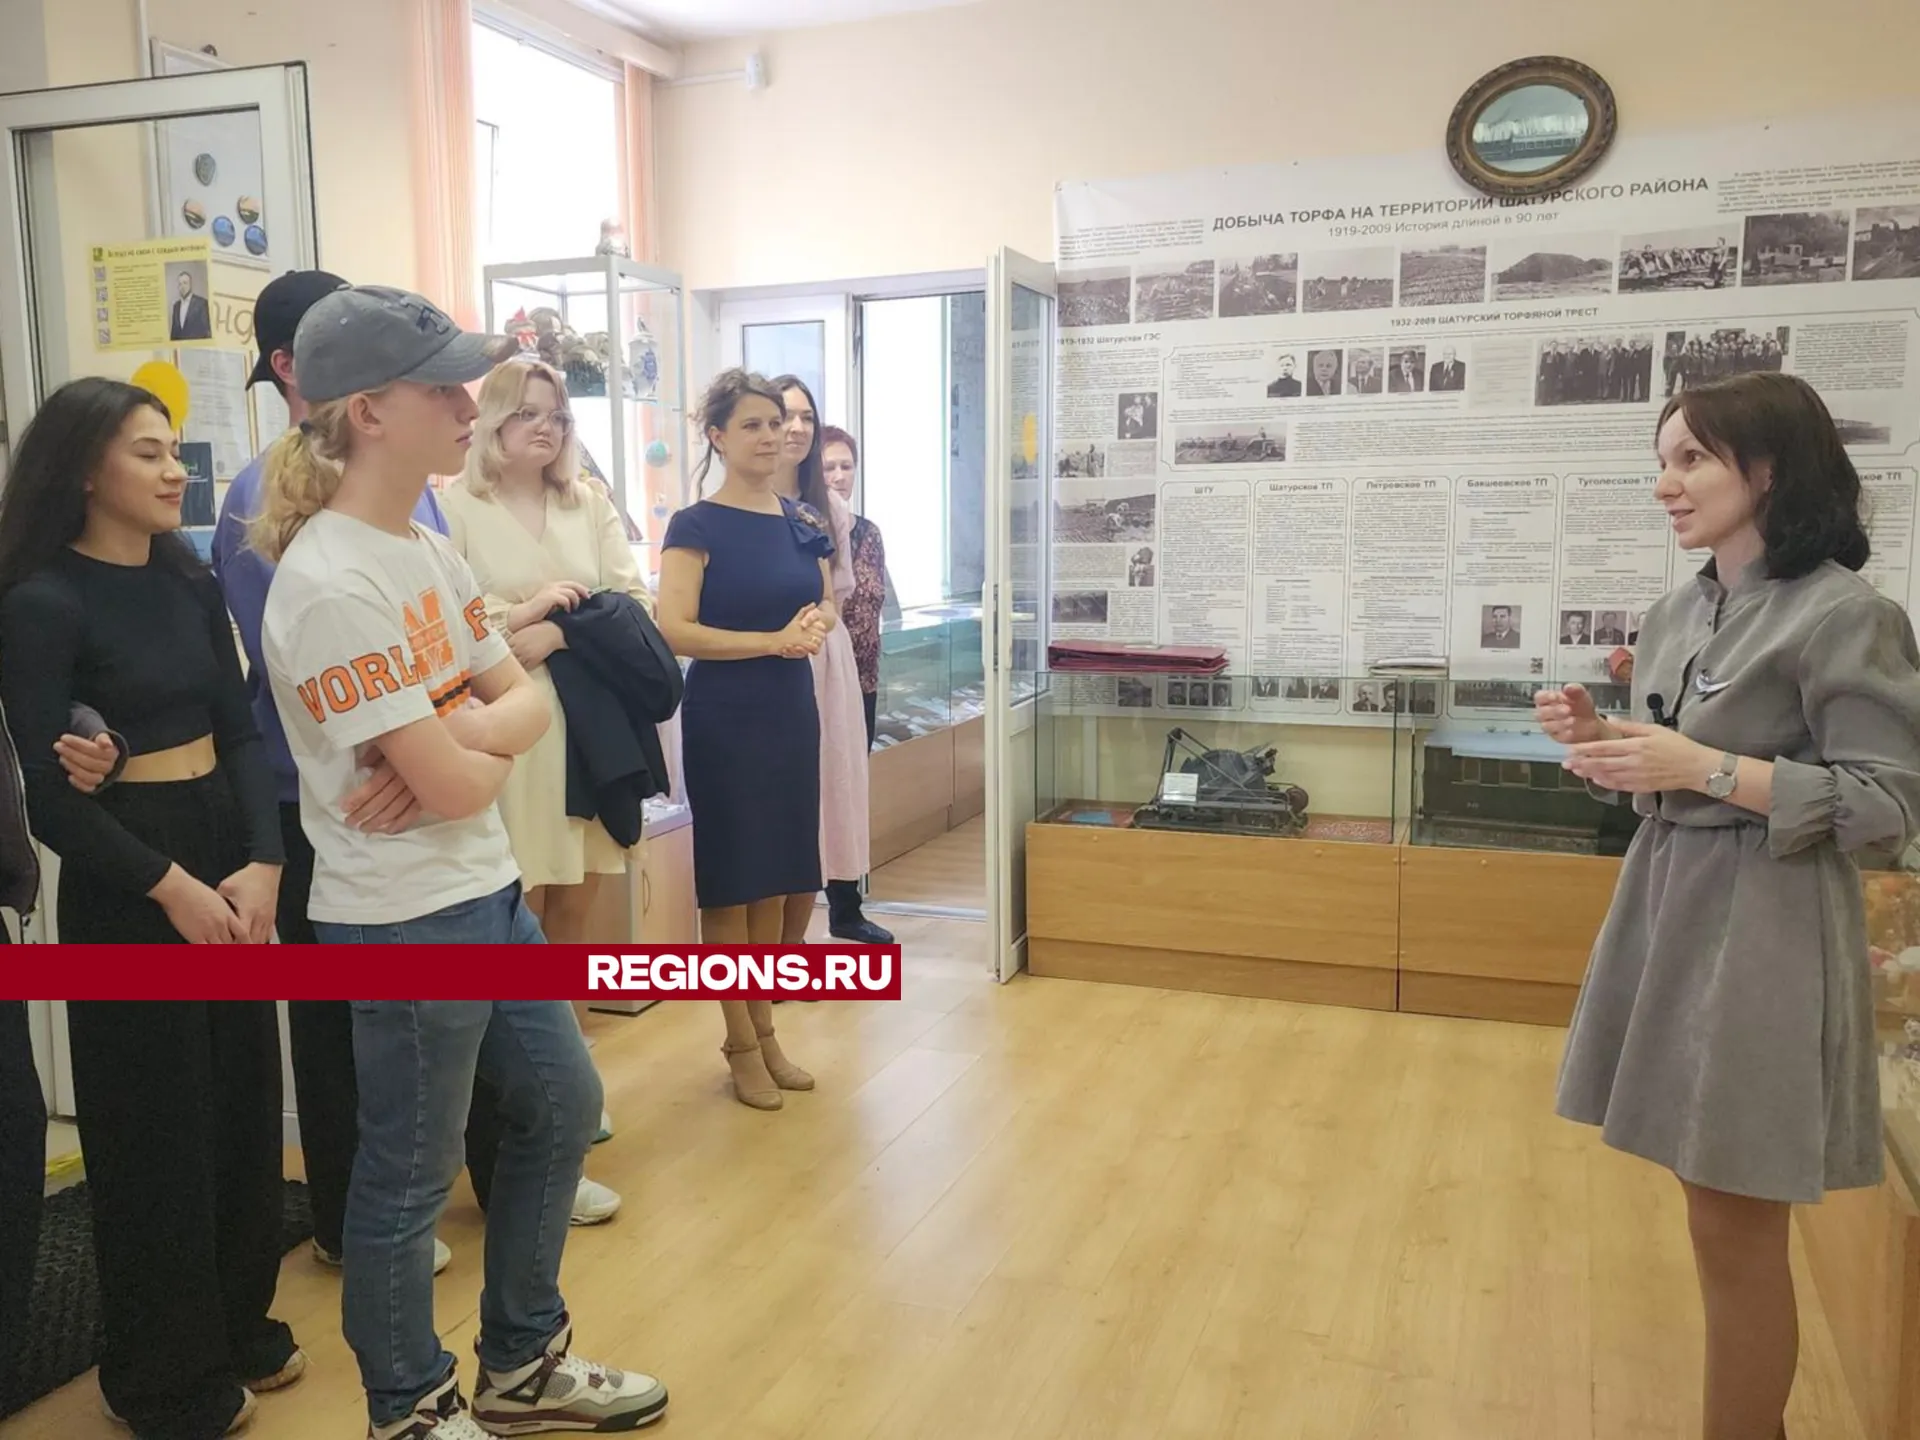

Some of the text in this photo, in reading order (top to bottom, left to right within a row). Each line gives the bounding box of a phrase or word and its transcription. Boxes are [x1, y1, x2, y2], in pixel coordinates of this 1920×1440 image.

[1212, 211, 1285, 232] ДОБЫЧА
[1290, 208, 1346, 224] ТОРФА
[1351, 206, 1374, 219] НА
[1379, 197, 1494, 217] ТЕРРИТОРИИ
[1629, 177, 1709, 196] РАЙОНА
[1329, 223, 1392, 238] 1919-2009
[1395, 220, 1449, 234] История
[1452, 214, 1500, 230] длиной
[1515, 211, 1532, 224] 90
[1438, 313, 1501, 325] ШАТУРСКИЙ
[1503, 308, 1562, 321] ТОРФЯНОЙ
[1565, 307, 1599, 317] ТРЕСТ
[1534, 477, 1548, 487] ТП
[1886, 471, 1902, 481] ТП
[1423, 480, 1436, 489] ТП
